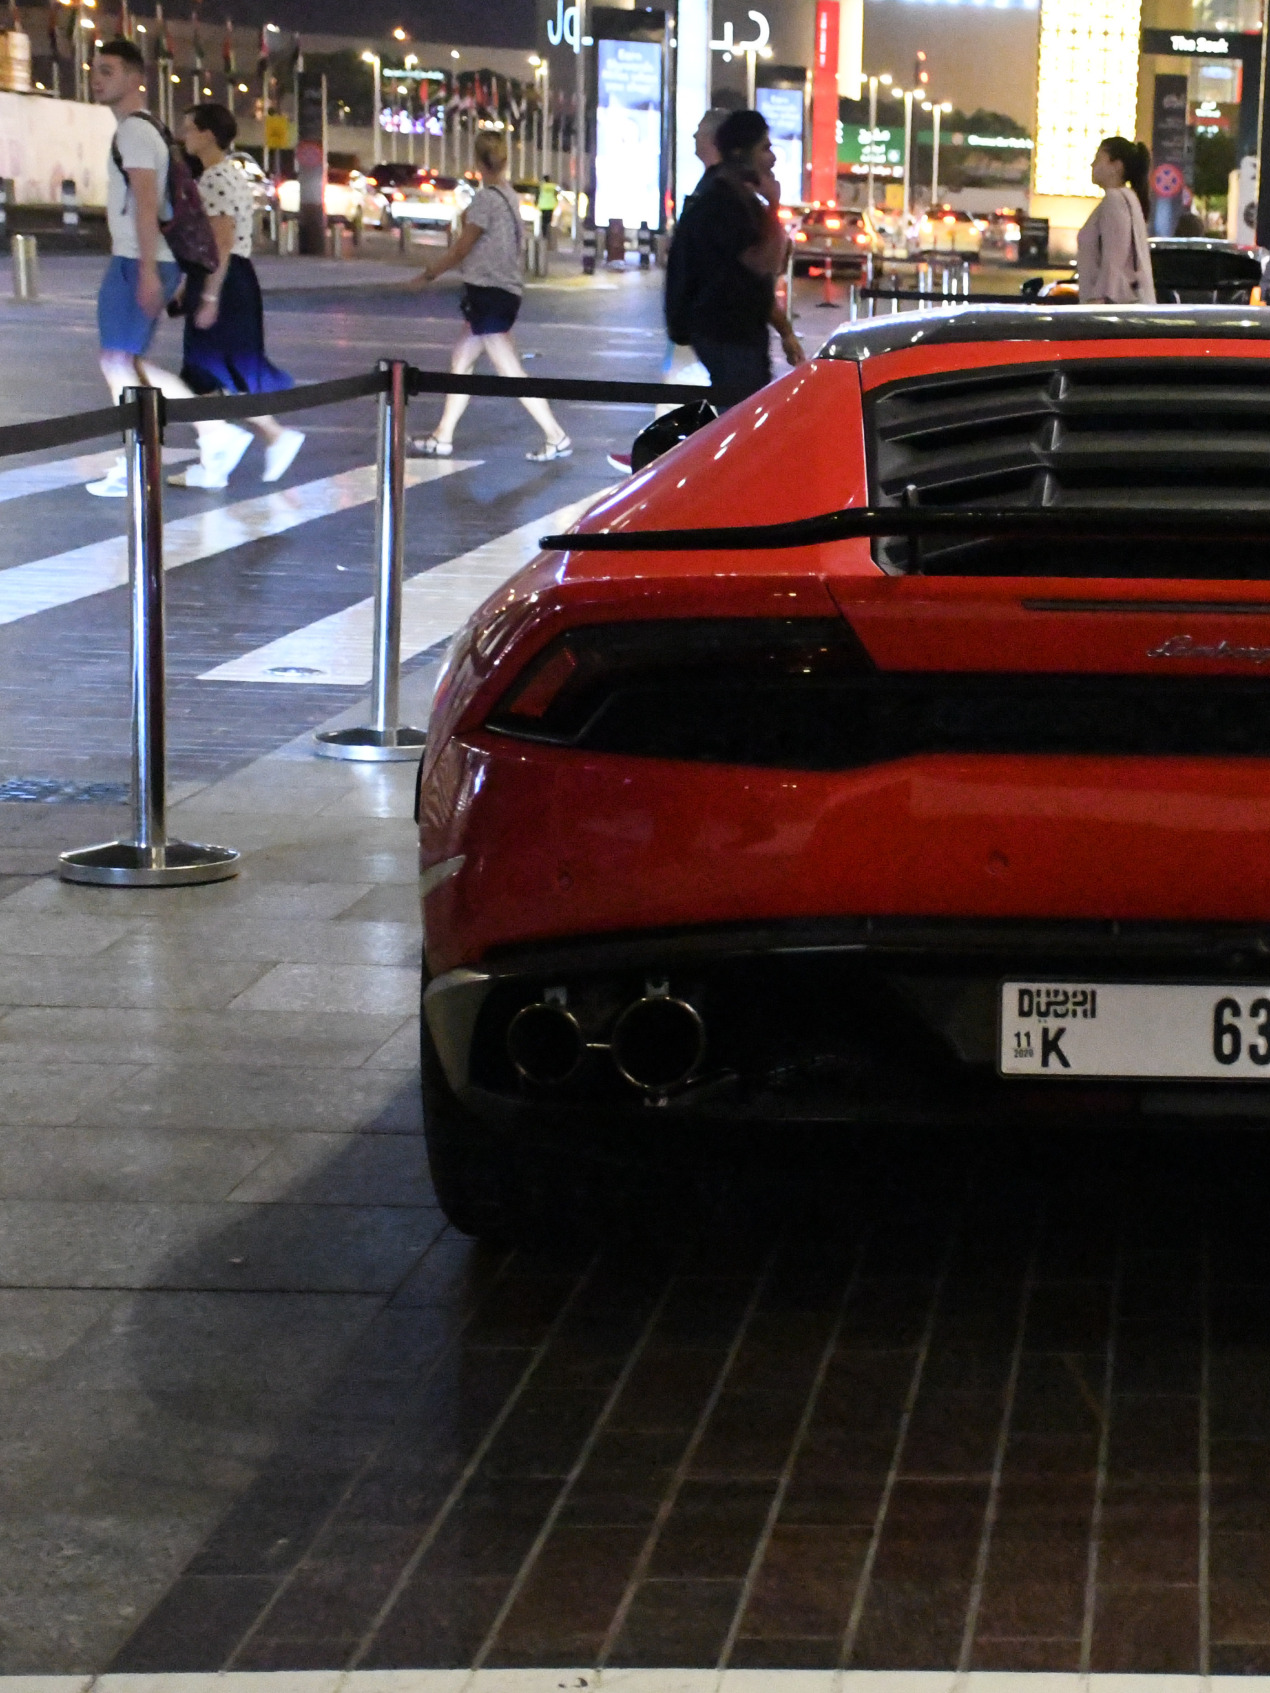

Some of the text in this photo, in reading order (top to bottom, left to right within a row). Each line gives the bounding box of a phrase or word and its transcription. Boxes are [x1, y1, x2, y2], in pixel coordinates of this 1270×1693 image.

[1170, 35, 1195, 52] The
[1018, 988, 1097, 1018] DUBAI
[1014, 1030, 1031, 1048] 11
[1041, 1026, 1071, 1068] K
